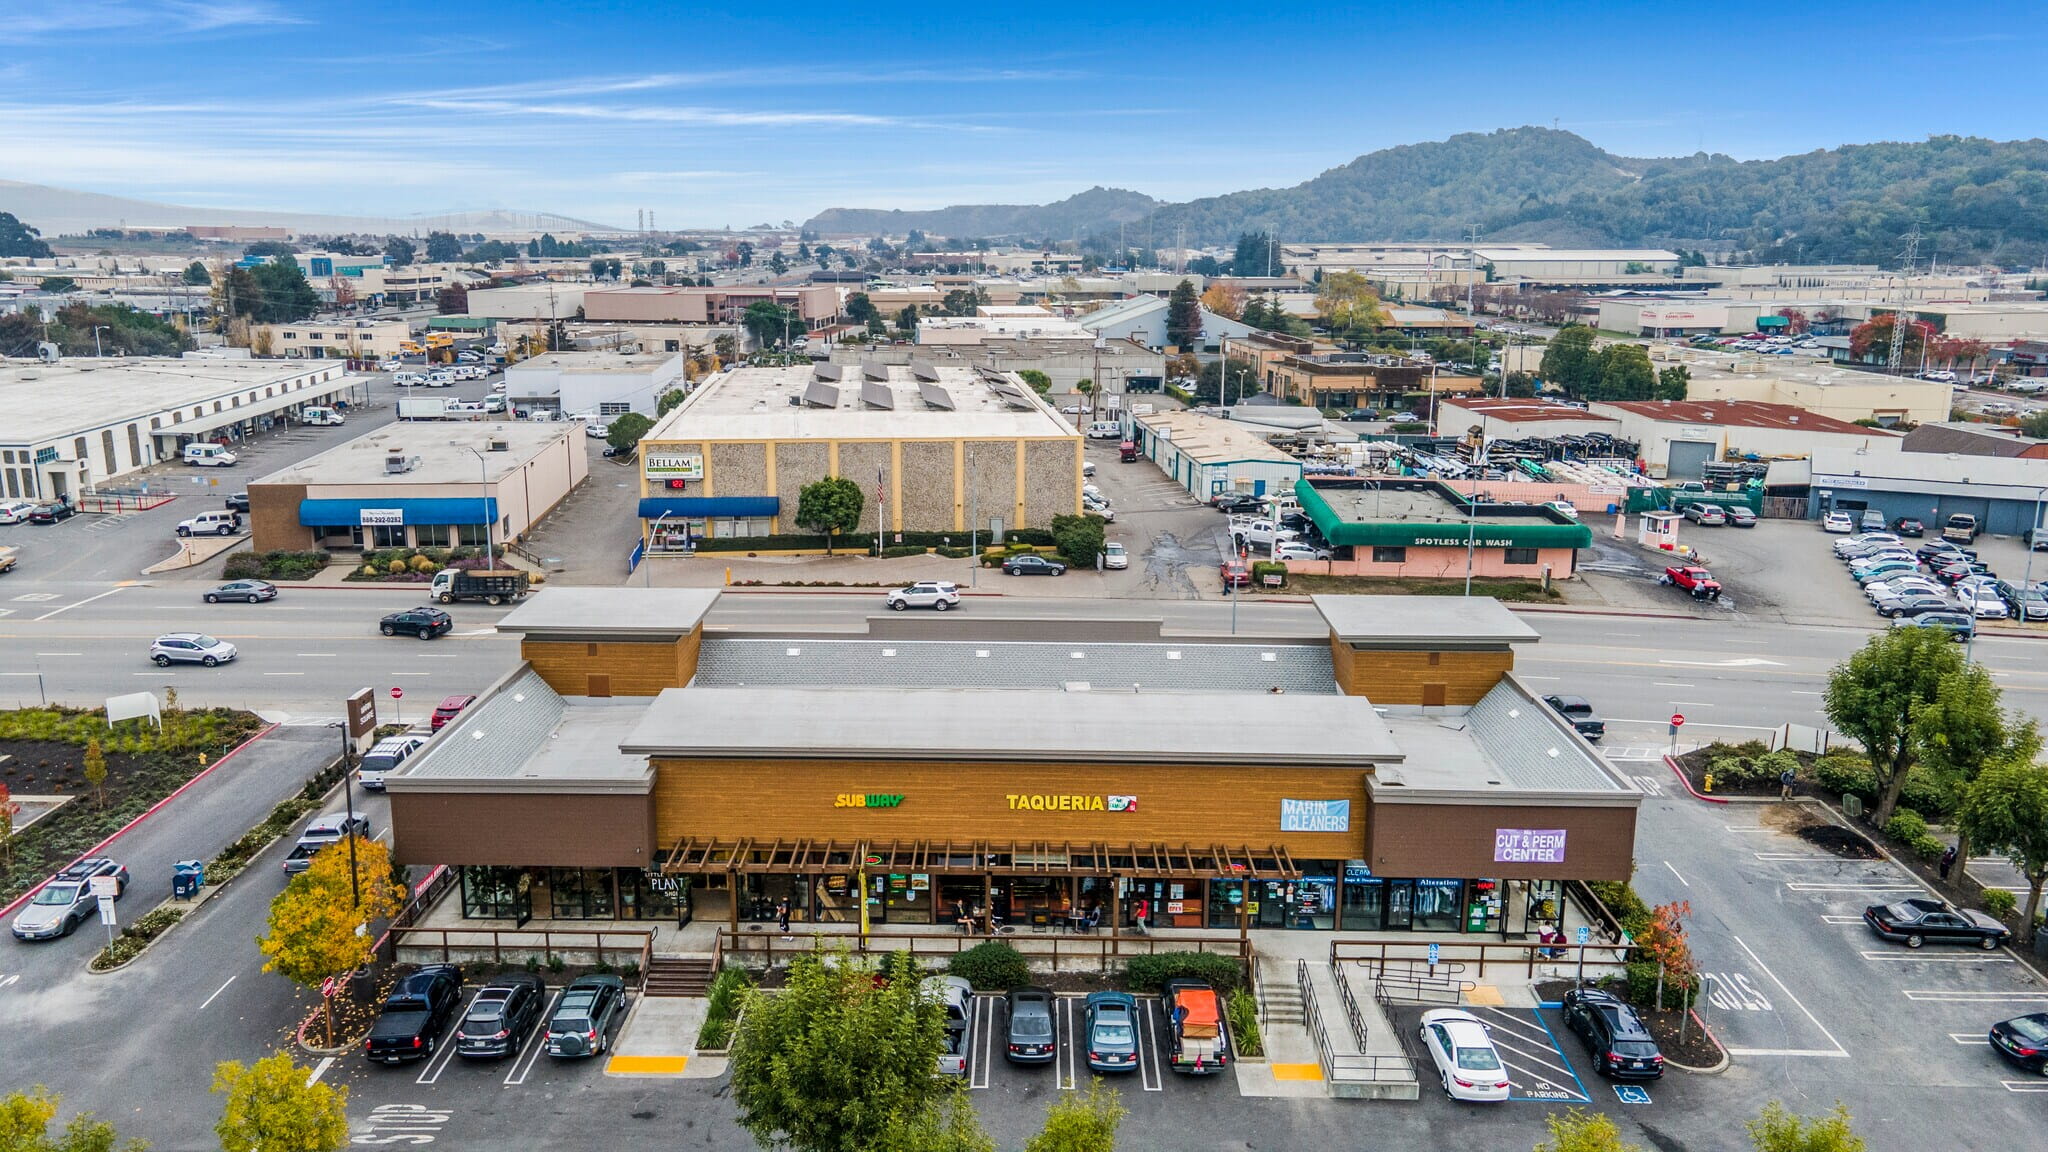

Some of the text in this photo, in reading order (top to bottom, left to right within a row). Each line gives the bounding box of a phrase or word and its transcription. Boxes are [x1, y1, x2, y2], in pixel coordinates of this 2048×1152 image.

[649, 458, 690, 467] BELLAM
[1415, 538, 1460, 546] SPOTLESS
[1485, 539, 1513, 547] WASH
[834, 794, 905, 808] SUBWAY
[1006, 794, 1105, 811] TAQUERIA
[1288, 815, 1346, 831] CLEANERS
[1497, 834, 1564, 848] CUT & PERM
[1503, 848, 1555, 861] CENTER
[651, 877, 684, 891] PLANT
[1535, 1082, 1551, 1090] NO
[1526, 1090, 1569, 1099] PARKING
[350, 1104, 454, 1145] STOP
